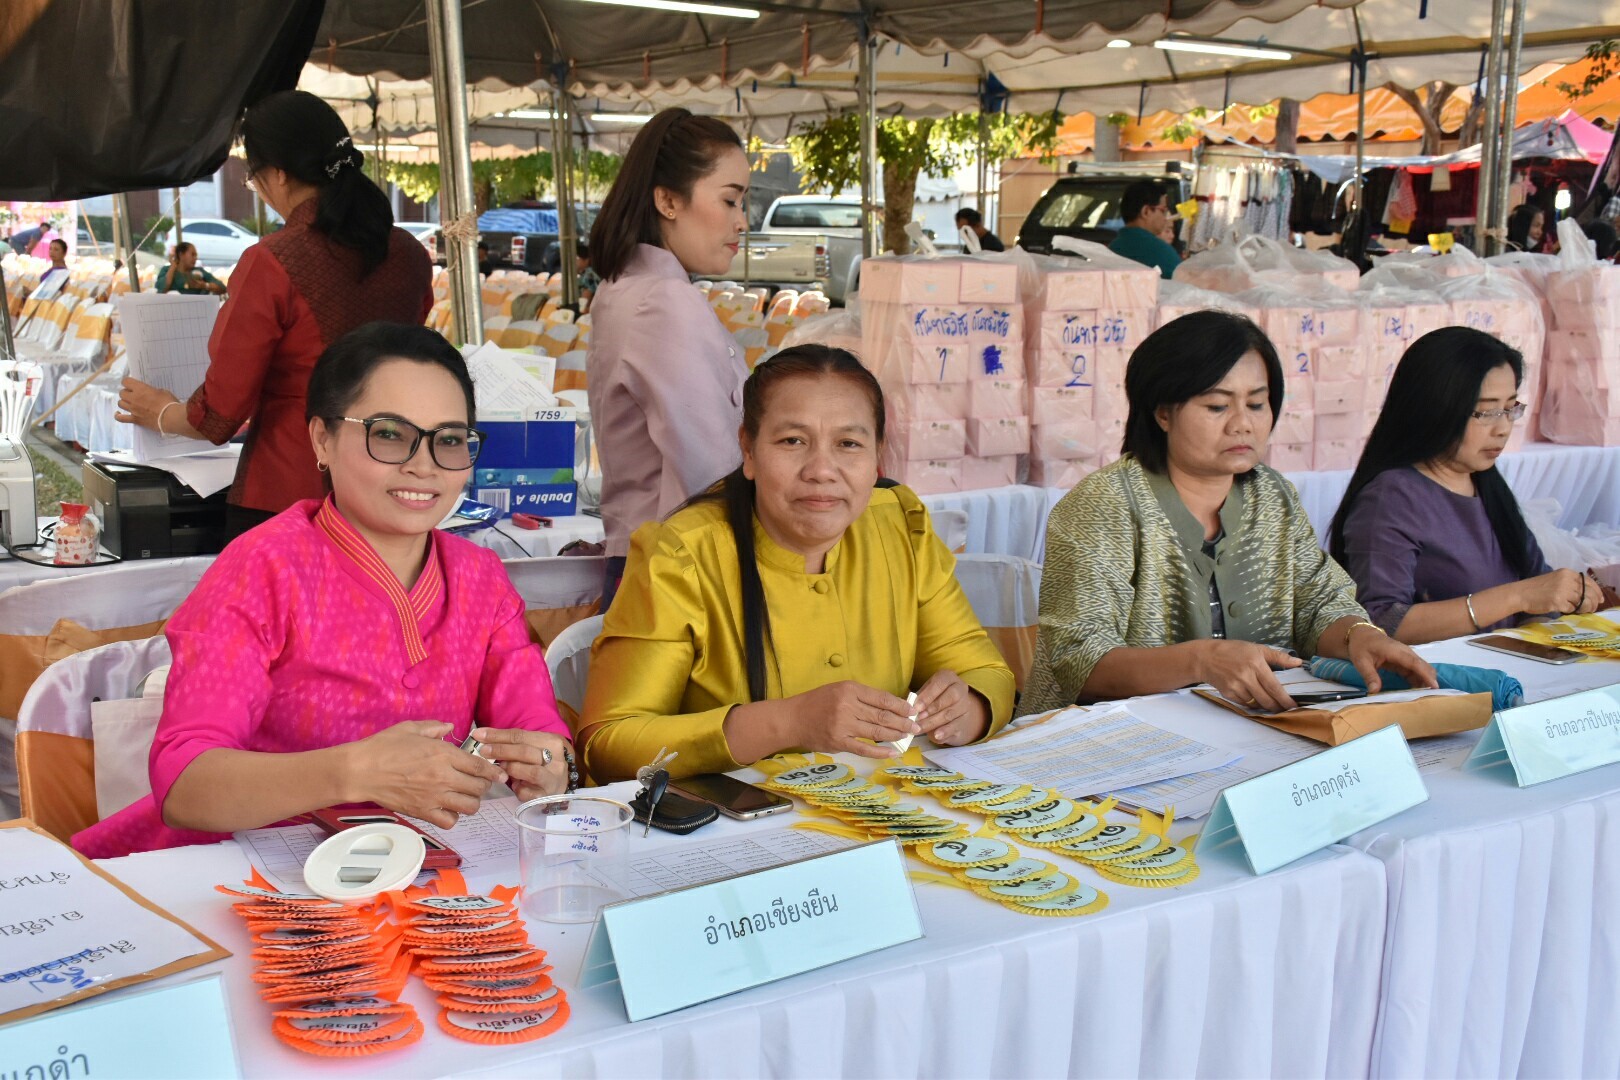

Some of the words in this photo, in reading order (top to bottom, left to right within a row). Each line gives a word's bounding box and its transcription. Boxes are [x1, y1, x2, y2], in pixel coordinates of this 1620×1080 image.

[1296, 351, 1309, 373] 2
[534, 410, 561, 420] 1759
[515, 494, 526, 506] A
[528, 492, 573, 505] Double
[1291, 762, 1361, 807] อำเภอกุดรัง
[0, 871, 71, 890] จำนว
[0, 910, 84, 937] อ.เชีย
[703, 887, 839, 945] อำเภอเชียงยืน
[475, 1012, 543, 1030] เชียงยืน
